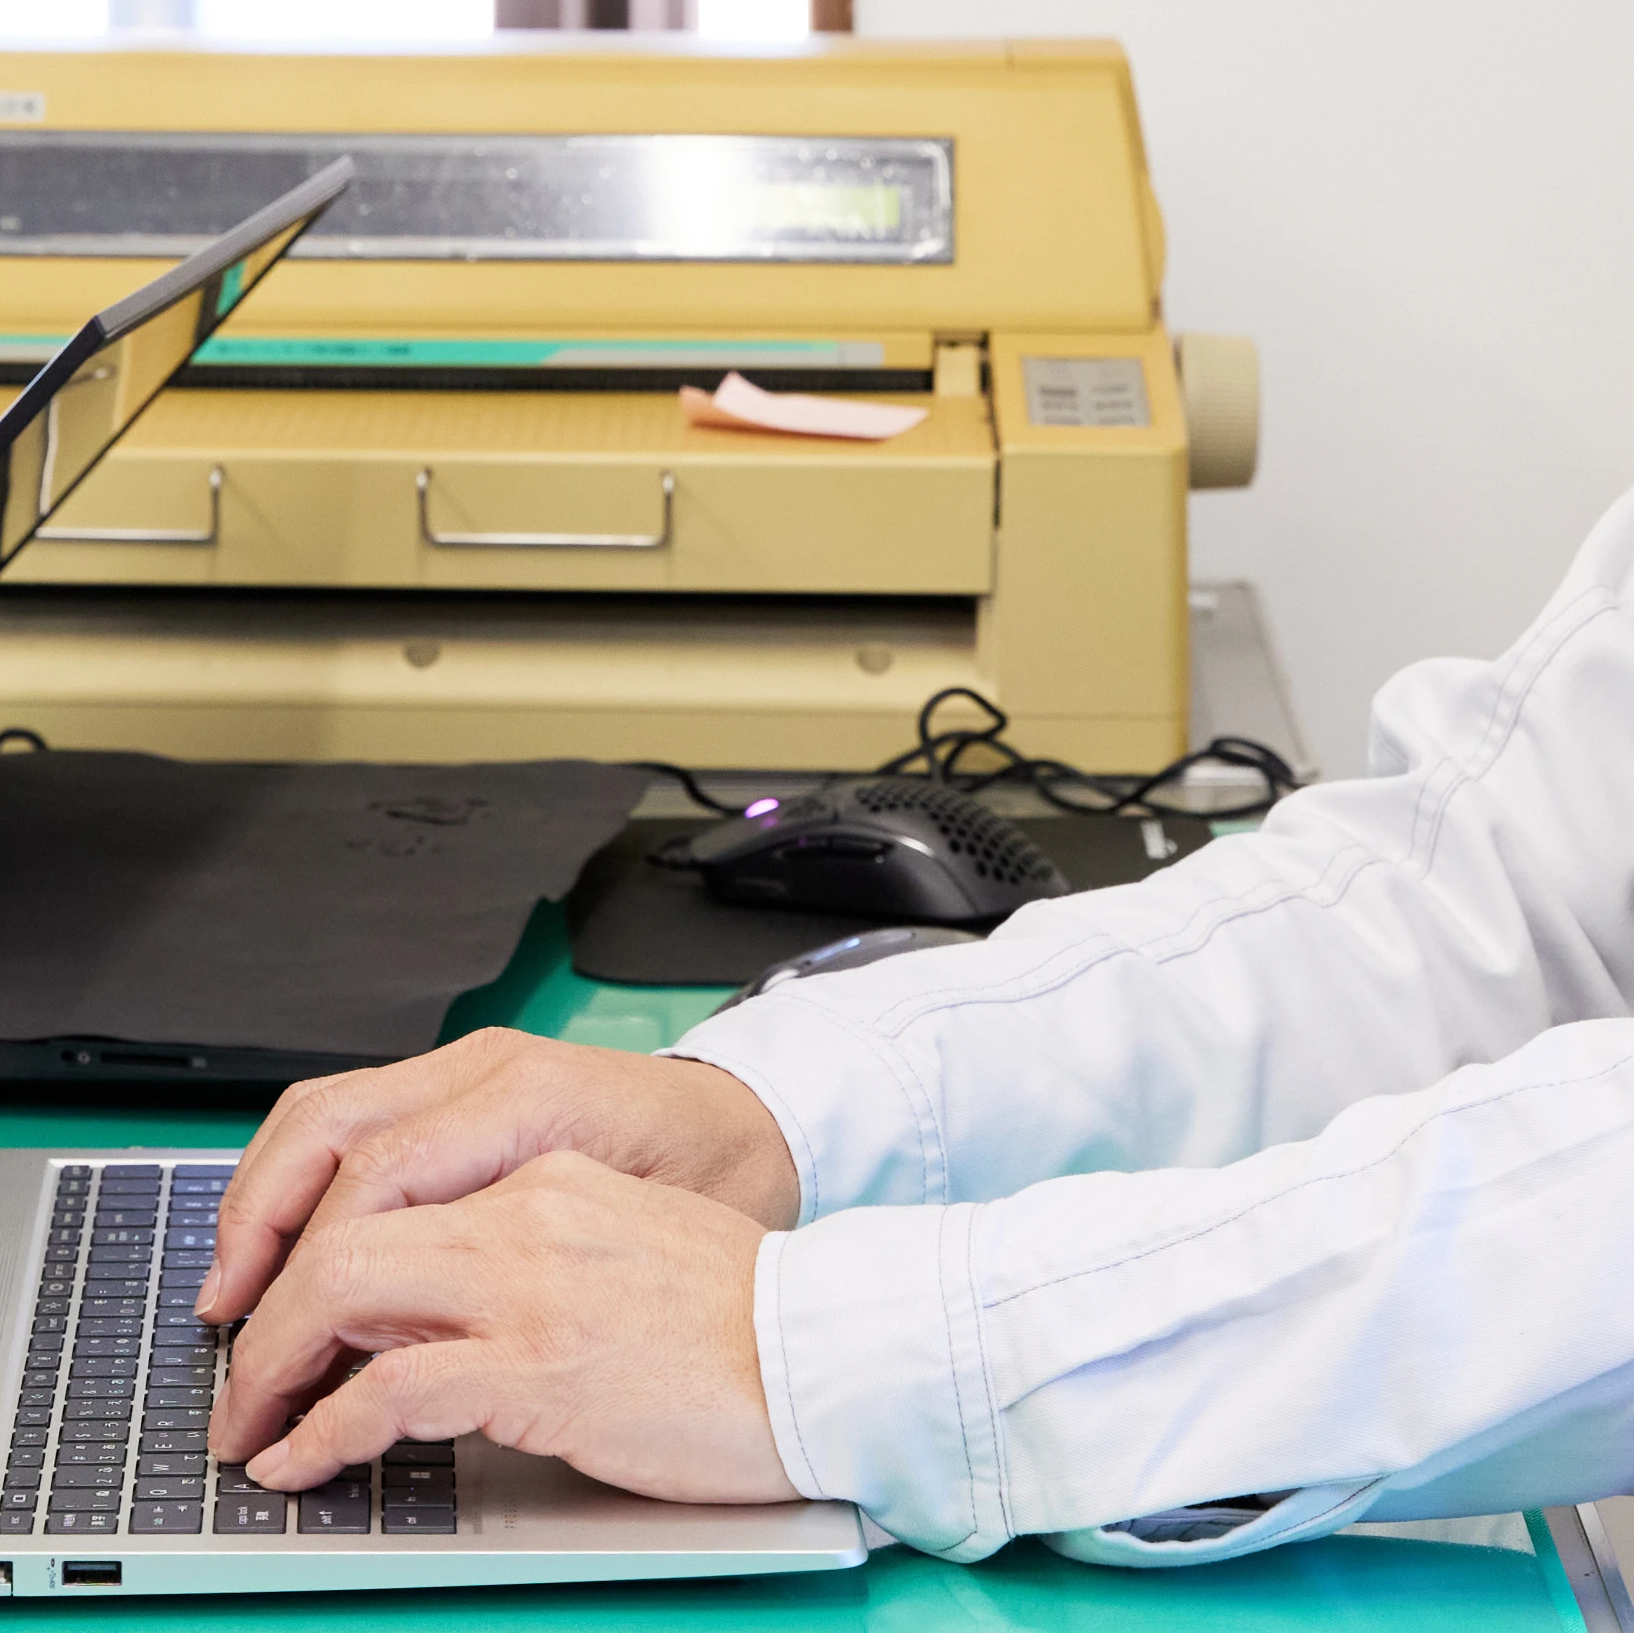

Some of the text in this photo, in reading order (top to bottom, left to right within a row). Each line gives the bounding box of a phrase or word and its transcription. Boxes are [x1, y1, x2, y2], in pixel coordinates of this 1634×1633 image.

[153, 1464, 170, 1472] W
[237, 1506, 248, 1525] caps lock
[320, 1515, 332, 1525] shift
